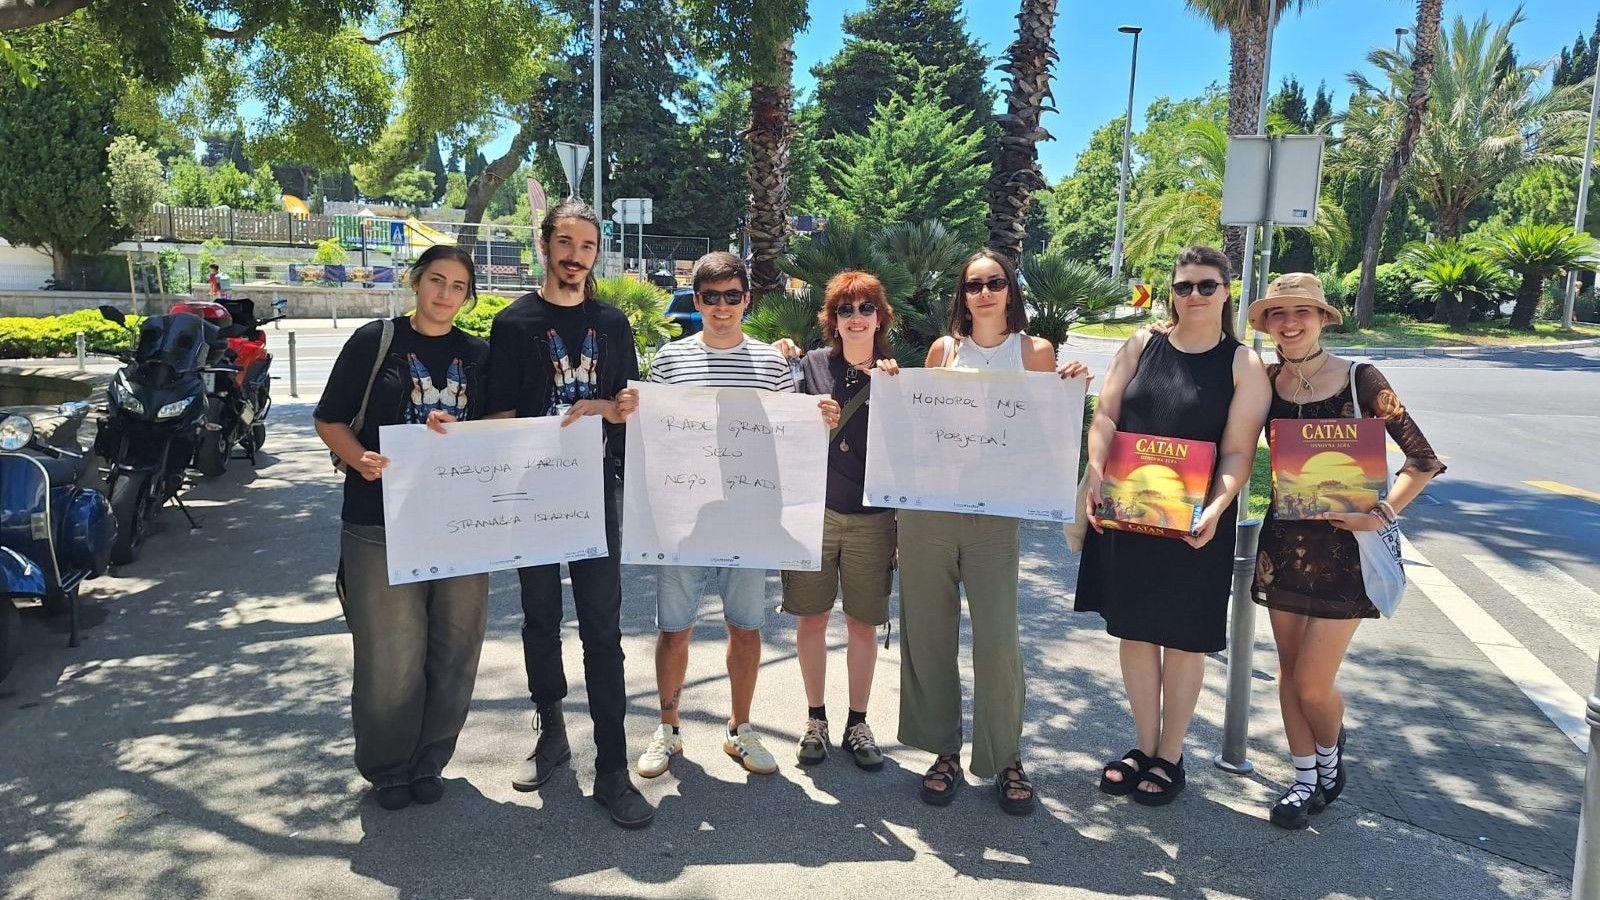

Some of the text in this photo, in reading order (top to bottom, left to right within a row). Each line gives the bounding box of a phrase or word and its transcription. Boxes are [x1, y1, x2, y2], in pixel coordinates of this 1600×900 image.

[912, 392, 979, 408] MONOPOL
[728, 420, 785, 438] GRADIM
[1302, 423, 1358, 440] CATAN
[935, 429, 1007, 448] POBJEDA!
[703, 445, 743, 458] SELO
[1135, 438, 1189, 458] CATAN
[524, 458, 579, 470] KARTICA
[664, 473, 706, 491] NEGO
[1128, 524, 1165, 535] CATAN
